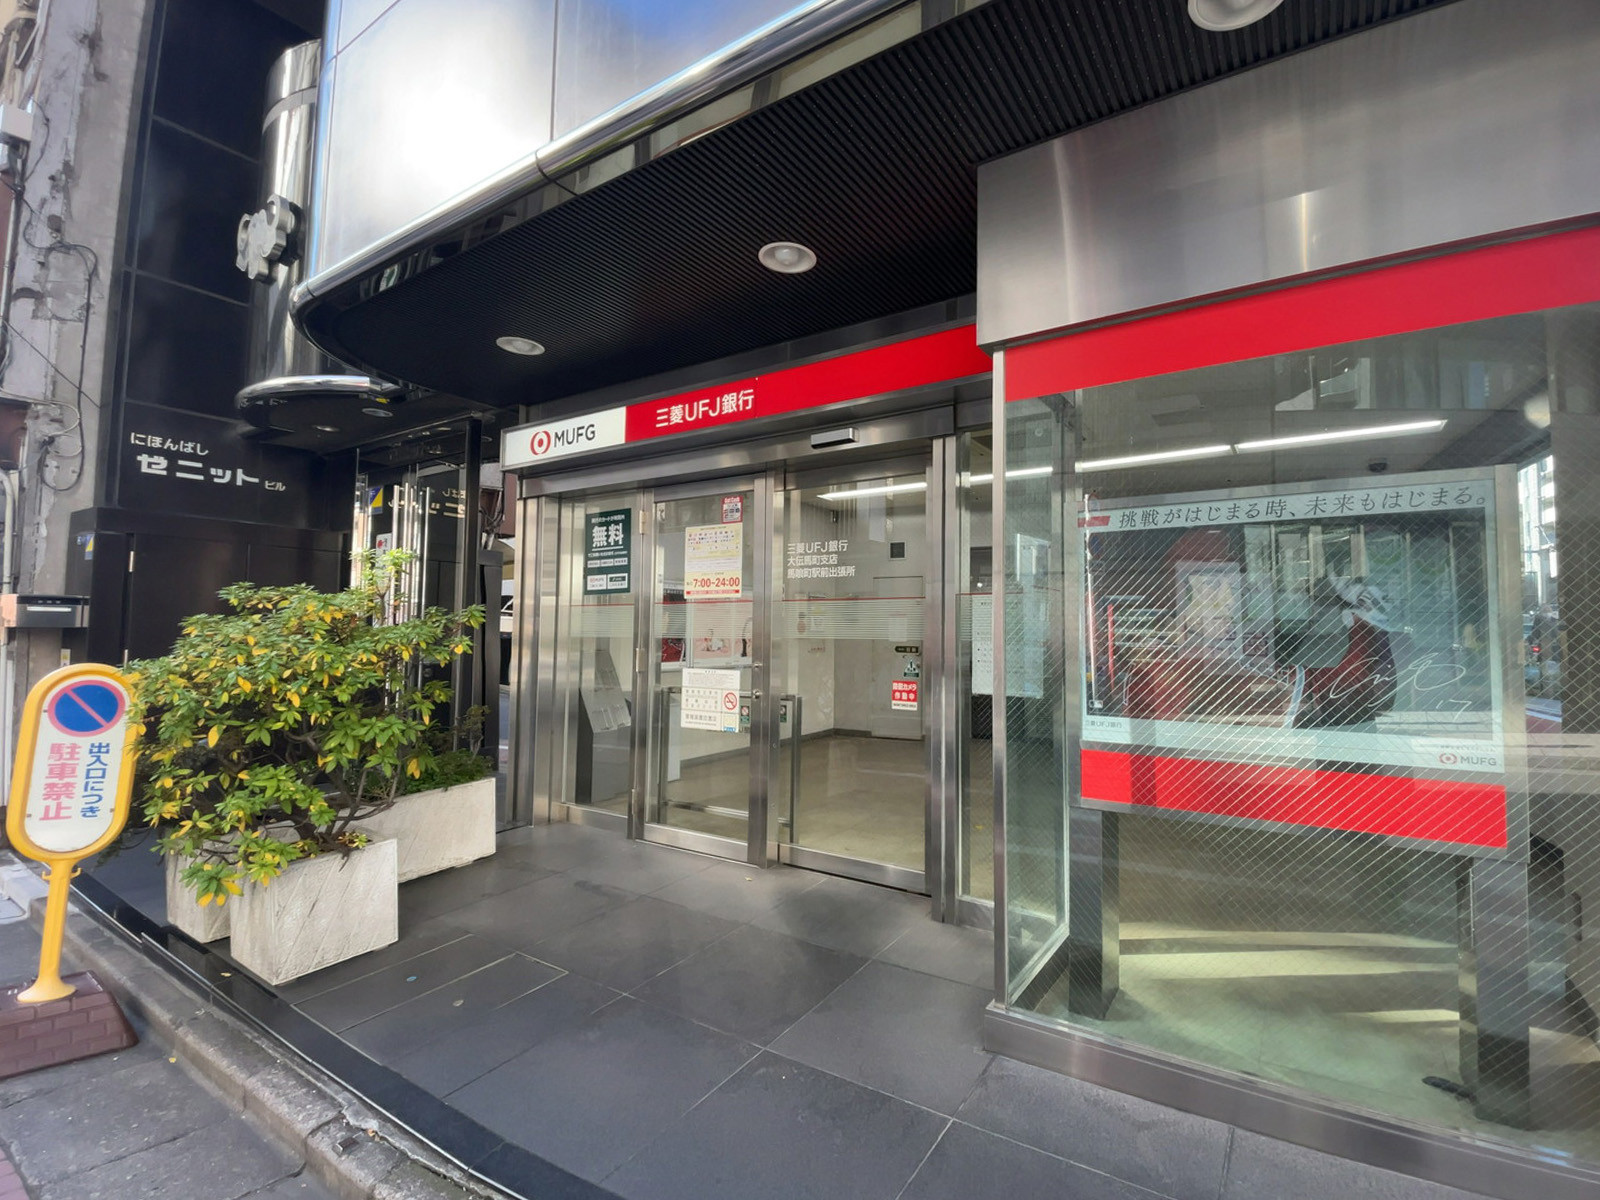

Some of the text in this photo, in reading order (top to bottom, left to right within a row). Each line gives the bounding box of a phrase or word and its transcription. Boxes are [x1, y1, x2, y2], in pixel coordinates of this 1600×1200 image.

[655, 389, 755, 428] 三菱UFJ銀行
[130, 432, 209, 456] にほんばし
[553, 424, 597, 448] MUFG
[592, 522, 624, 547] 無料
[787, 540, 849, 554] 三菱UFJ銀行
[1460, 754, 1497, 766] MUFG
[39, 743, 82, 821] 駐車禁止
[80, 742, 110, 819] 出入口につき
